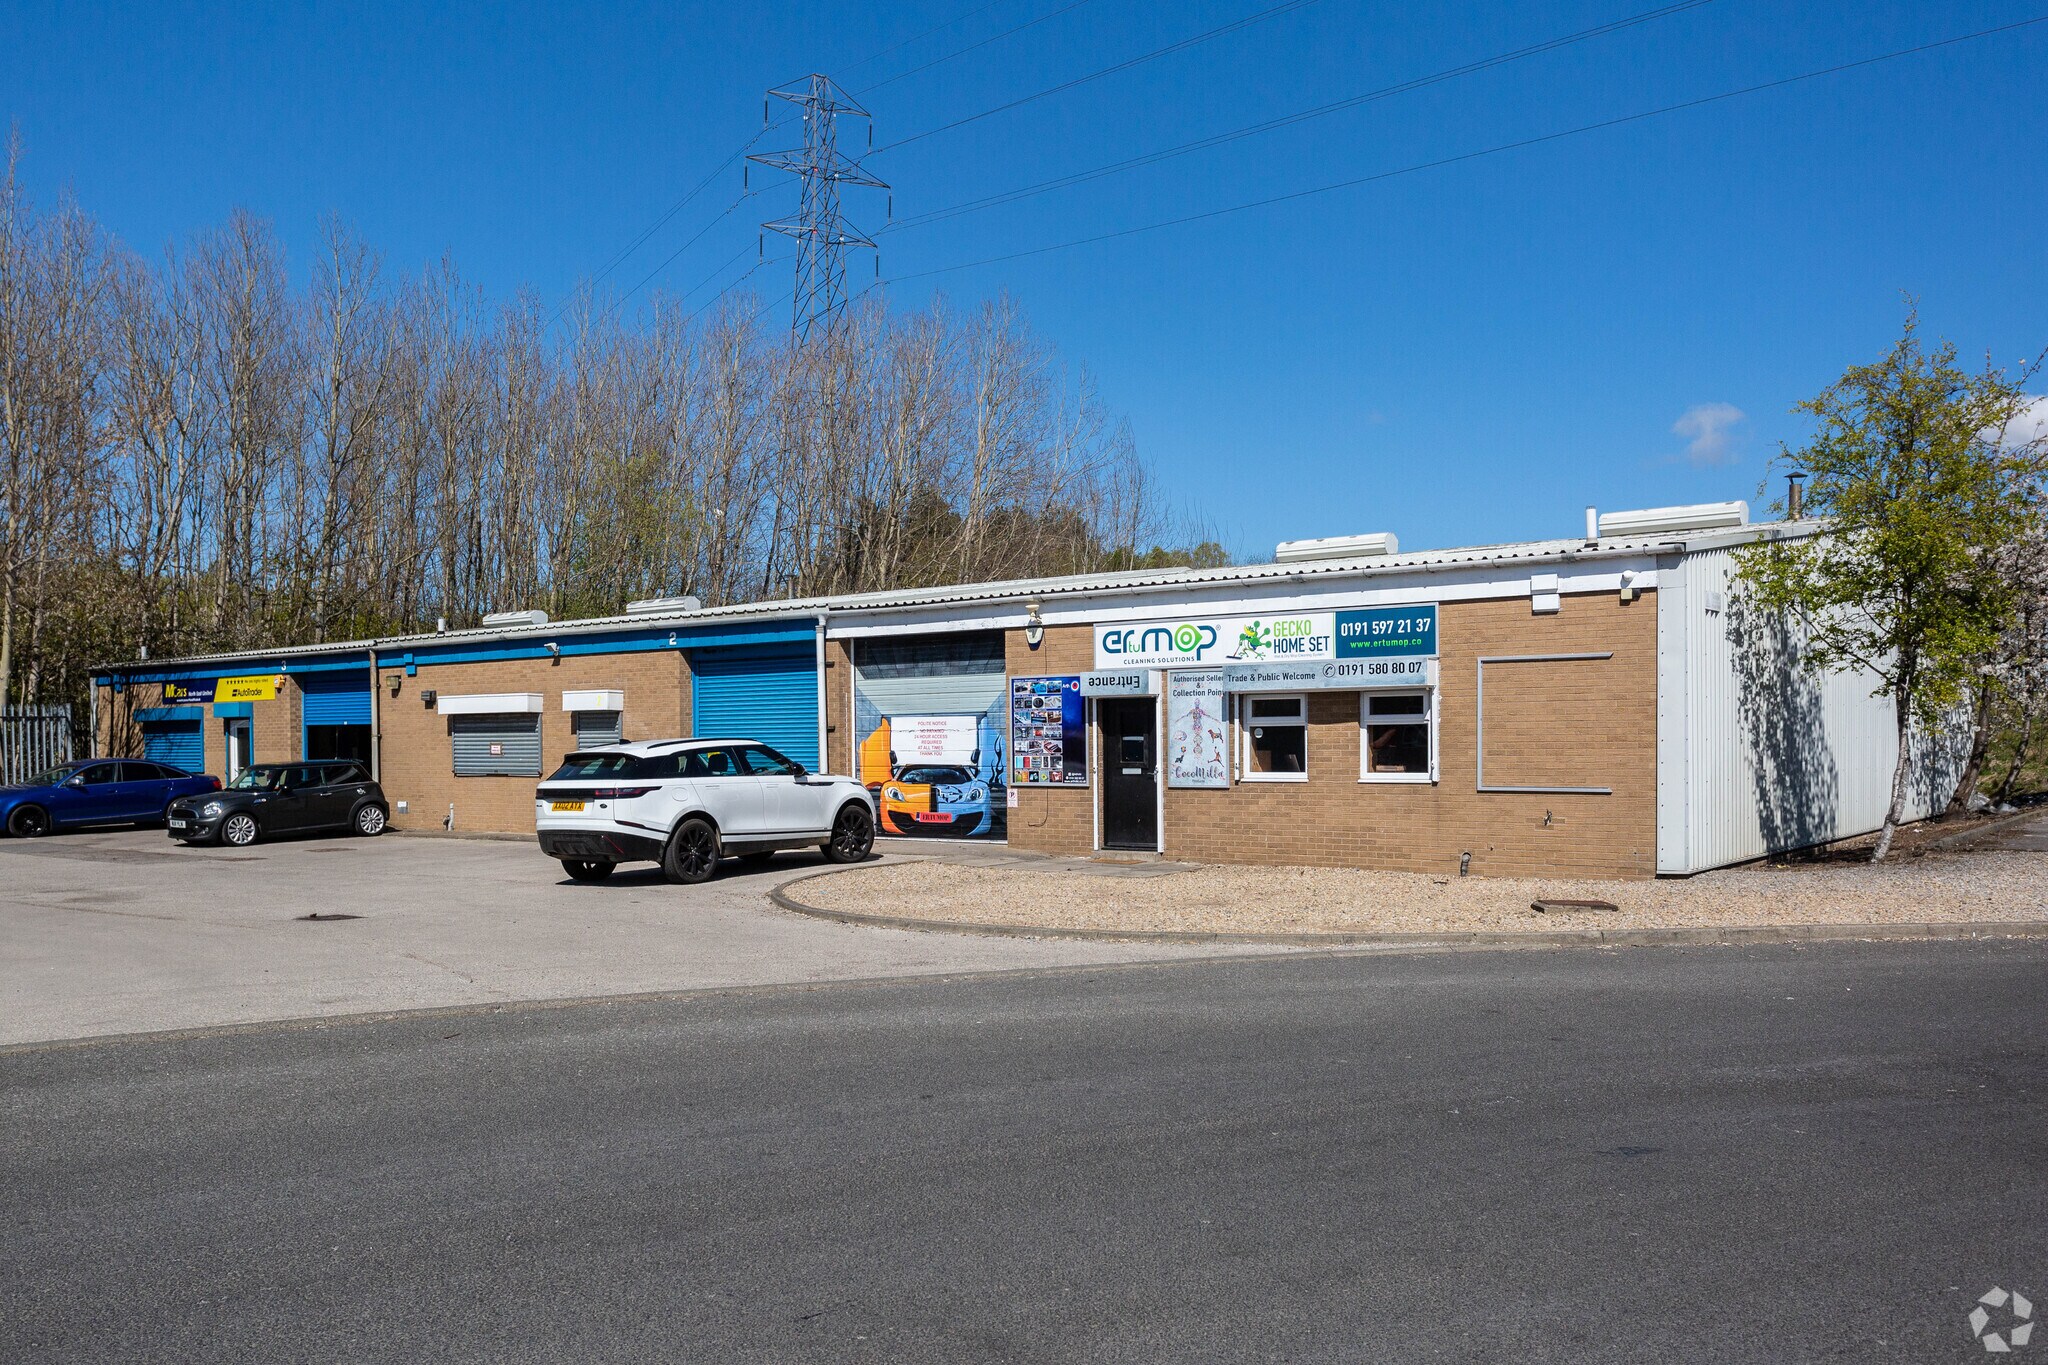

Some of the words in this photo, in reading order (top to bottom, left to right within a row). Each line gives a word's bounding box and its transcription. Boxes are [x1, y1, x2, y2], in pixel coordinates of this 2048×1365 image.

[1273, 619, 1312, 638] GECKO
[1340, 622, 1368, 637] 0191
[1372, 620, 1394, 635] 597
[1397, 619, 1410, 634] 21
[1416, 617, 1431, 632] 37
[669, 631, 677, 645] 2
[1350, 638, 1422, 649] www.ertumop.co
[1273, 637, 1305, 654] HOME
[1308, 635, 1330, 652] SET
[281, 661, 287, 671] 3
[1123, 657, 1156, 665] CLEANING
[1158, 656, 1195, 664] SOLUTIONS
[1338, 664, 1364, 676] 0191
[1368, 663, 1388, 675] 580
[1391, 662, 1405, 674] 80
[1408, 661, 1422, 674] 07
[1088, 675, 1140, 689] Entrance
[1173, 674, 1205, 683] Authorised
[1228, 674, 1248, 682] Trade
[1250, 674, 1256, 682] &
[1257, 672, 1280, 682] Public
[1282, 672, 1316, 681] Welcome
[1172, 688, 1206, 698] Collection
